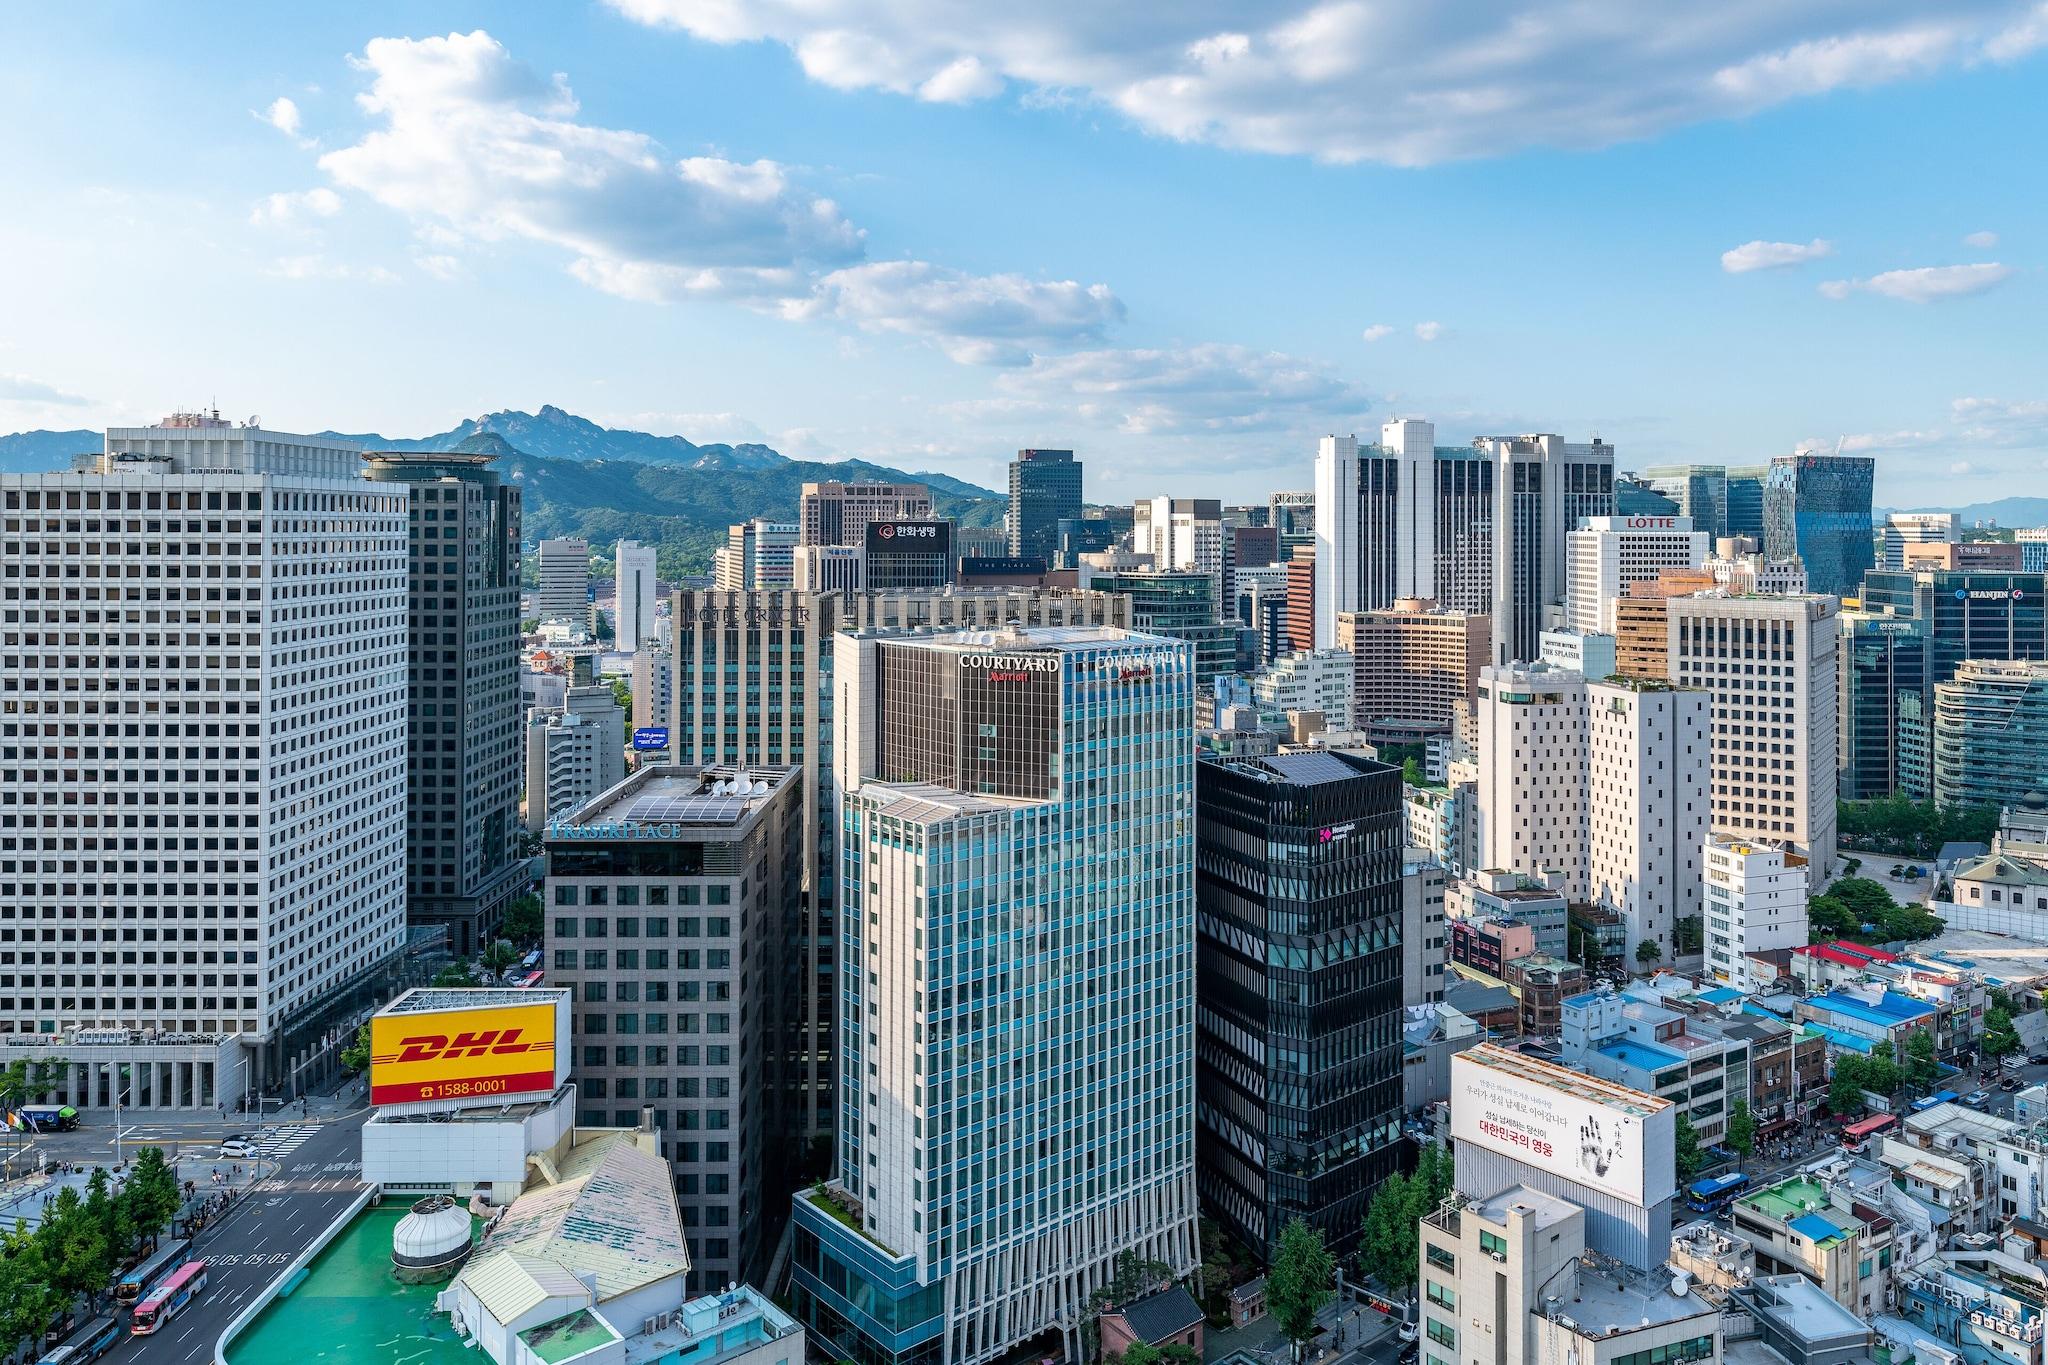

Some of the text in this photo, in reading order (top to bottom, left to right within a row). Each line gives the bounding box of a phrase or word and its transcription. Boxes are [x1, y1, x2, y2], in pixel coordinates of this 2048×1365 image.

[896, 526, 936, 537] 한화생명
[1628, 518, 1675, 528] LOTTE
[1969, 590, 2009, 600] HANJIN
[1095, 651, 1175, 669] COURTYARD
[1542, 648, 1580, 660] THE SPLAISIR
[959, 655, 1059, 673] COURTYARD
[989, 671, 1029, 682] Marriott
[551, 820, 682, 839] FRASER PLACE
[397, 1028, 532, 1063] DHL
[437, 1079, 507, 1097] 1588-0001
[1467, 1085, 1568, 1128] 우리가 성실 납세로 이어갑니다
[1485, 1110, 1547, 1140] 성실 납세하는 당신이
[1479, 1120, 1553, 1157] 대한민국의 영웅
